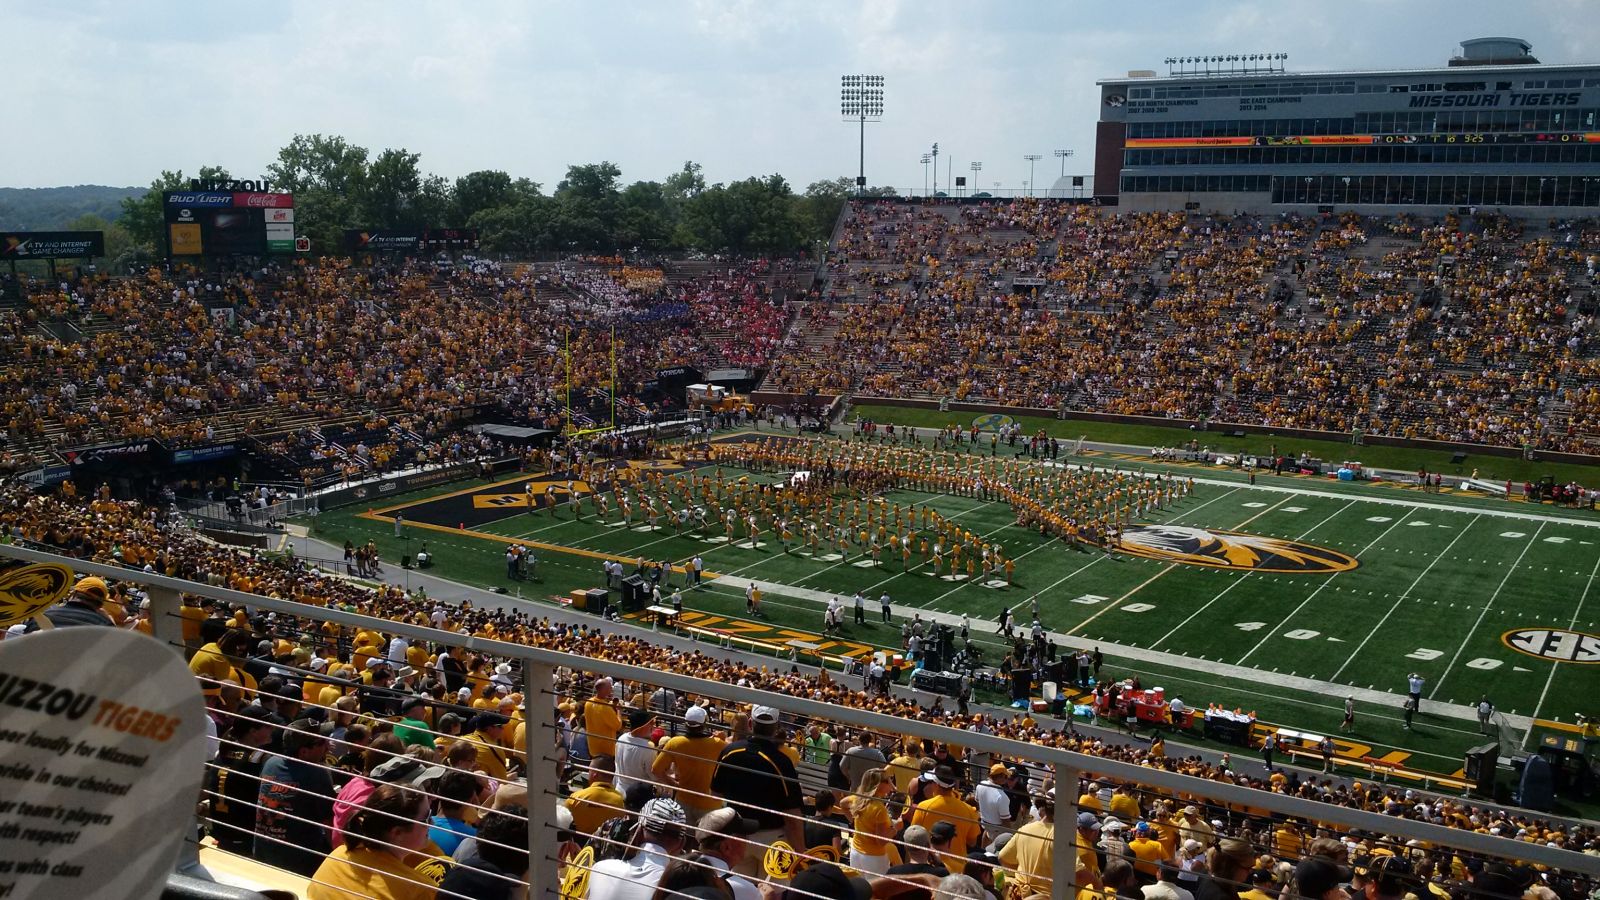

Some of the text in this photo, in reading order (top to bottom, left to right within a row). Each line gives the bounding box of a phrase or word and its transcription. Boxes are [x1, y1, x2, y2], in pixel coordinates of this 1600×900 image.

[1409, 92, 1581, 108] MISSOURI TIGERS
[191, 178, 269, 192] MIZZOU
[169, 195, 232, 203] BUD LIGHT
[91, 699, 182, 742] TIGERS
[25, 730, 73, 756] loudly
[73, 740, 97, 757] for
[95, 746, 149, 768] Mizzou!
[35, 768, 51, 783] in
[52, 774, 79, 787] our
[78, 776, 133, 796] choices!
[18, 801, 64, 819] team's
[62, 807, 114, 826] players
[21, 827, 81, 846] respect!
[15, 858, 49, 874] with
[51, 861, 84, 877] class
